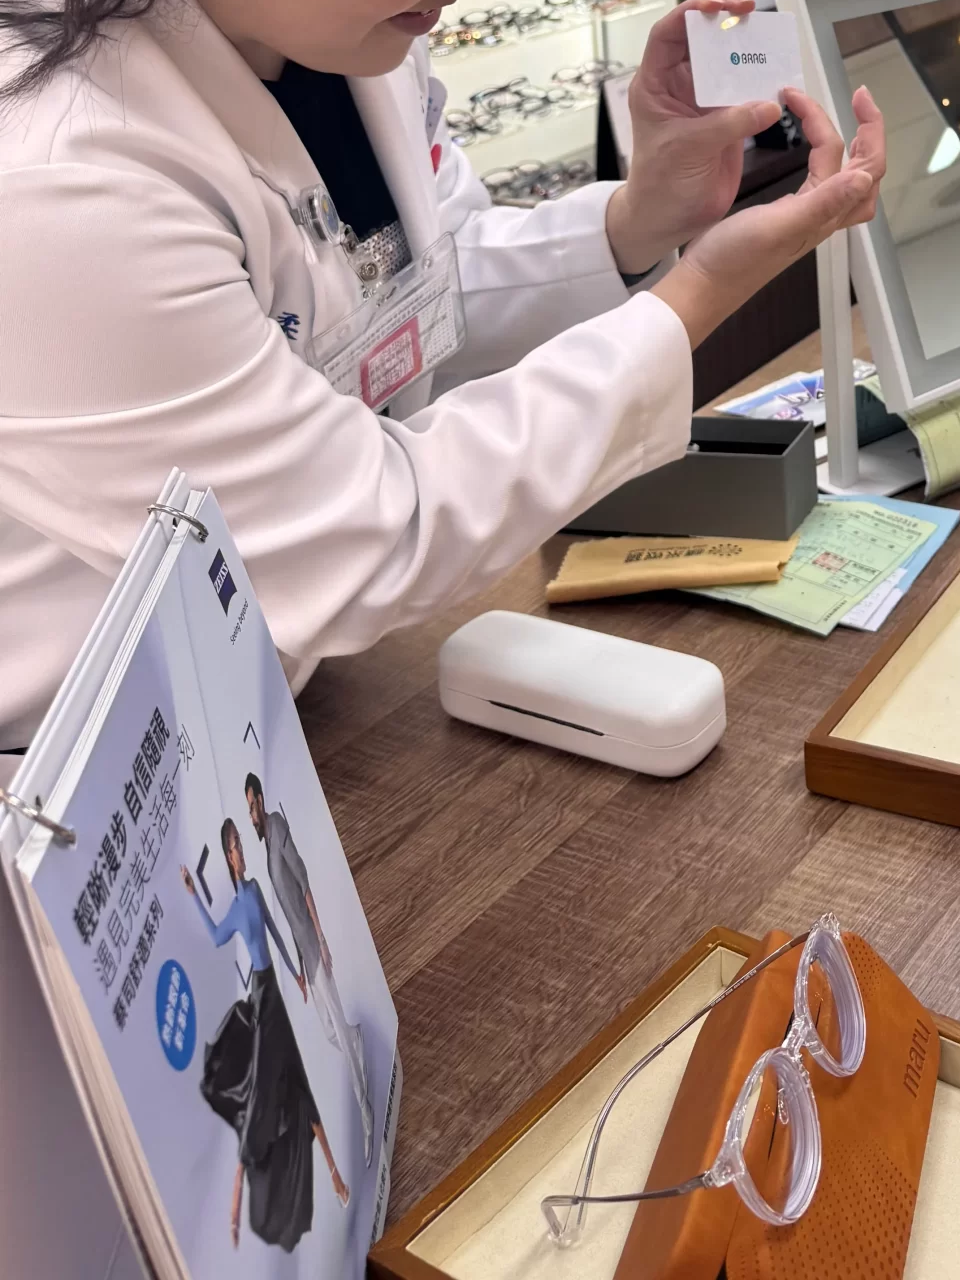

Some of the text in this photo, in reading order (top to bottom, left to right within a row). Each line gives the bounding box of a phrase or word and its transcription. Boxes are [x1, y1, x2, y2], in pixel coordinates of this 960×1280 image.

[213, 561, 230, 595] ZEISS
[72, 706, 170, 947] 輕晰漫步 自信隨視
[93, 723, 195, 996] 遇見完美生活每一刻
[113, 893, 165, 1033] 蔡司舒適系列
[903, 1018, 931, 1099] maru
